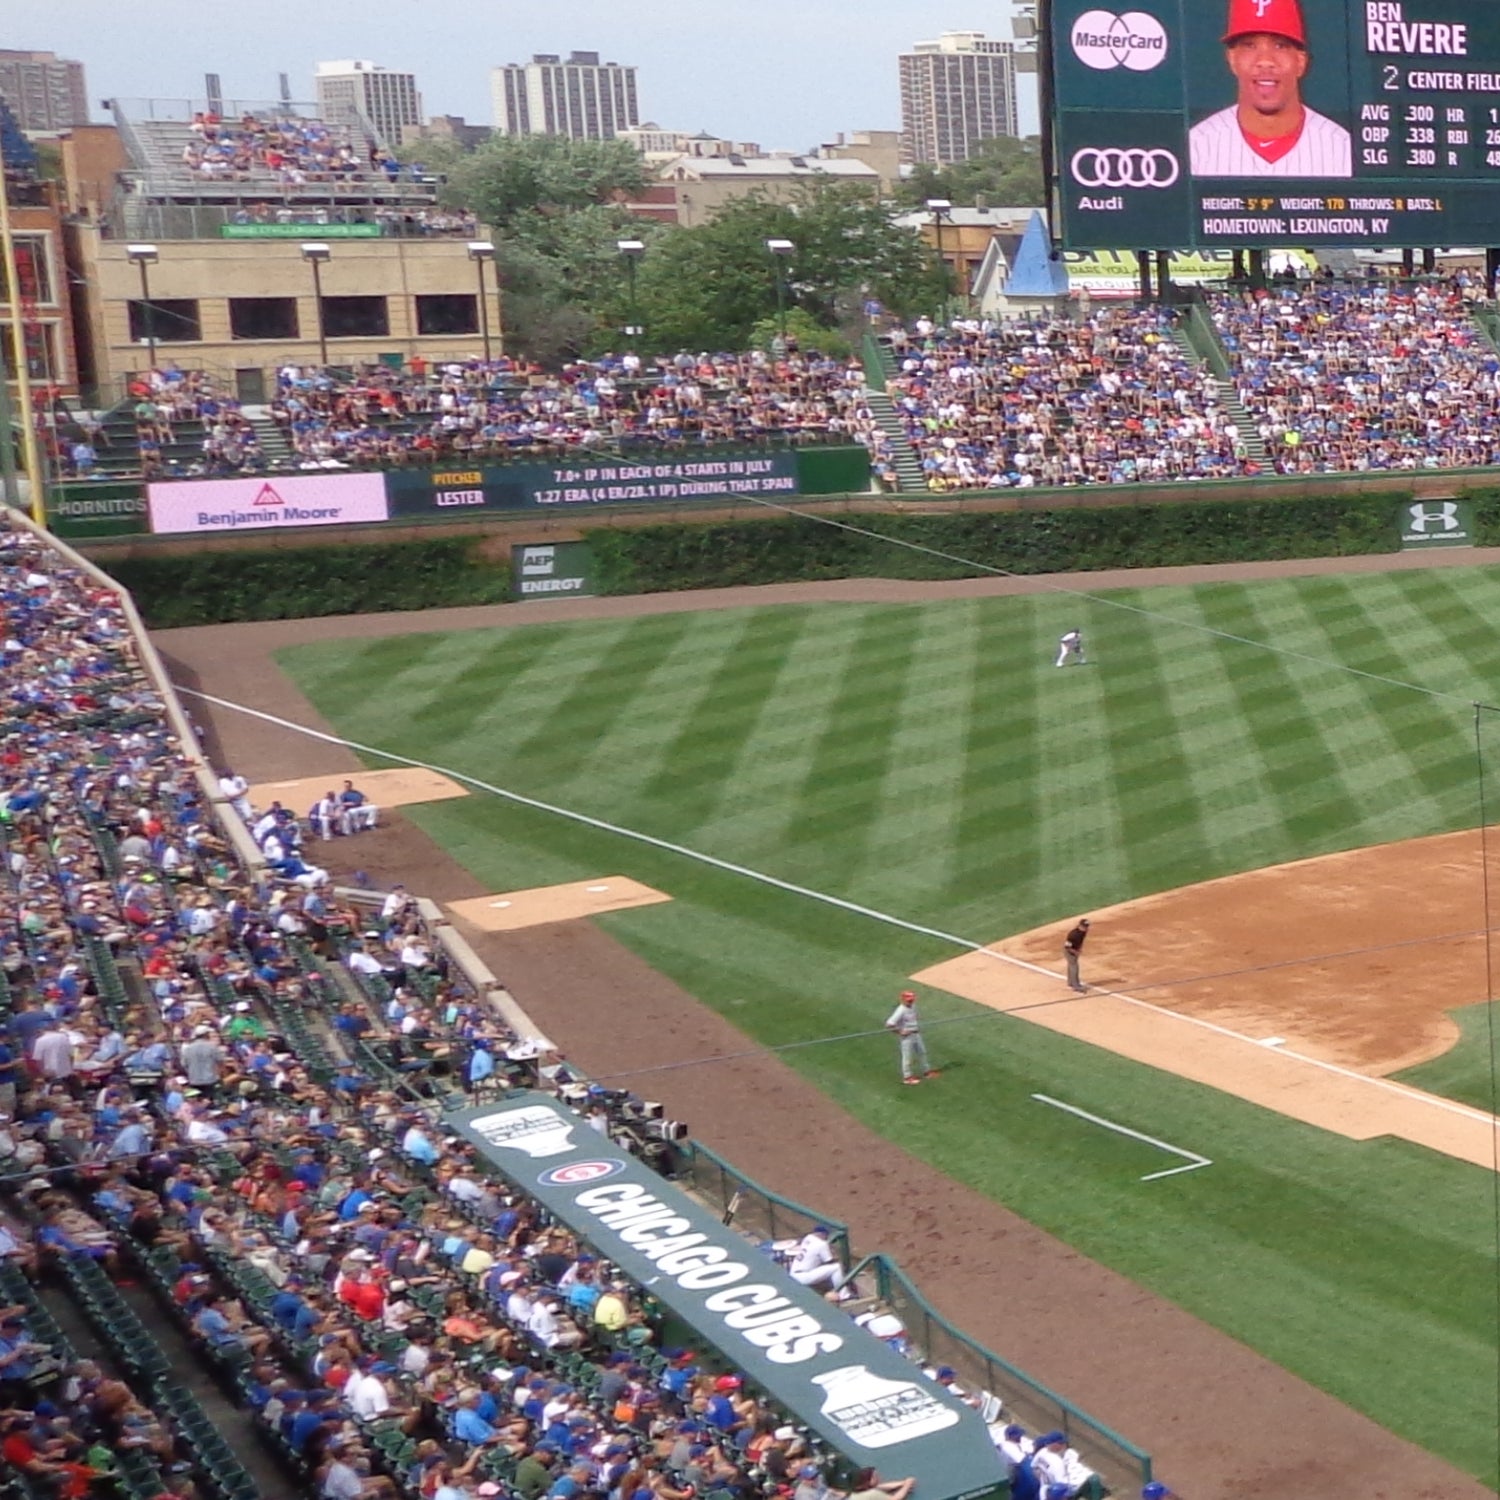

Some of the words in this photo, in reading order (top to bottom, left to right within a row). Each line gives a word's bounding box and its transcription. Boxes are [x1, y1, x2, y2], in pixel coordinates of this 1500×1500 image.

[1366, 2, 1401, 22] BEN
[1075, 32, 1163, 50] MasterCard
[1368, 22, 1467, 54] REVERE
[1383, 66, 1399, 90] 2
[1408, 72, 1463, 89] CENTER
[1361, 105, 1389, 120] AVG
[1405, 106, 1434, 121] .300
[1447, 109, 1465, 122] HR
[1489, 108, 1498, 123] 1
[1362, 127, 1389, 142] OBP
[1406, 128, 1435, 143] .338
[1448, 130, 1468, 144] RBI
[1363, 149, 1388, 164] SLG
[1406, 150, 1435, 165] .380
[1448, 152, 1457, 165] R
[1078, 197, 1123, 210] Audi
[1202, 198, 1244, 210] HEIGHT:
[1280, 198, 1324, 210] WEIGHT:
[1327, 198, 1344, 210] 170
[1349, 198, 1394, 210] THROWS:
[1407, 198, 1434, 210] BATS:
[1435, 198, 1442, 211] L
[1203, 219, 1286, 234] HOMETOWN:
[1290, 219, 1368, 235] LEXINGTON,
[1372, 219, 1389, 233] KY
[432, 472, 483, 485] PITCHER
[584, 469, 597, 482] IP
[601, 468, 617, 481] IN
[619, 466, 651, 480] EACH
[655, 465, 671, 478] OF
[674, 464, 682, 476] 4
[684, 463, 727, 476] STARTS
[729, 462, 744, 474] IN
[746, 460, 773, 474] JULY
[437, 491, 484, 506] LESTER
[534, 491, 561, 504] 1.27
[565, 489, 589, 502] ERA
[592, 487, 605, 502] (4
[679, 481, 726, 496] DURING
[728, 480, 759, 493] THAT
[762, 478, 793, 492] SPAN
[58, 498, 147, 516] HORNITOS
[198, 509, 278, 527] Benjamin
[284, 506, 339, 521] Moore
[523, 554, 554, 567] AEP
[522, 578, 584, 593] ENERGY
[575, 1183, 748, 1289] CHICAGO
[705, 1284, 843, 1364] CUBS
